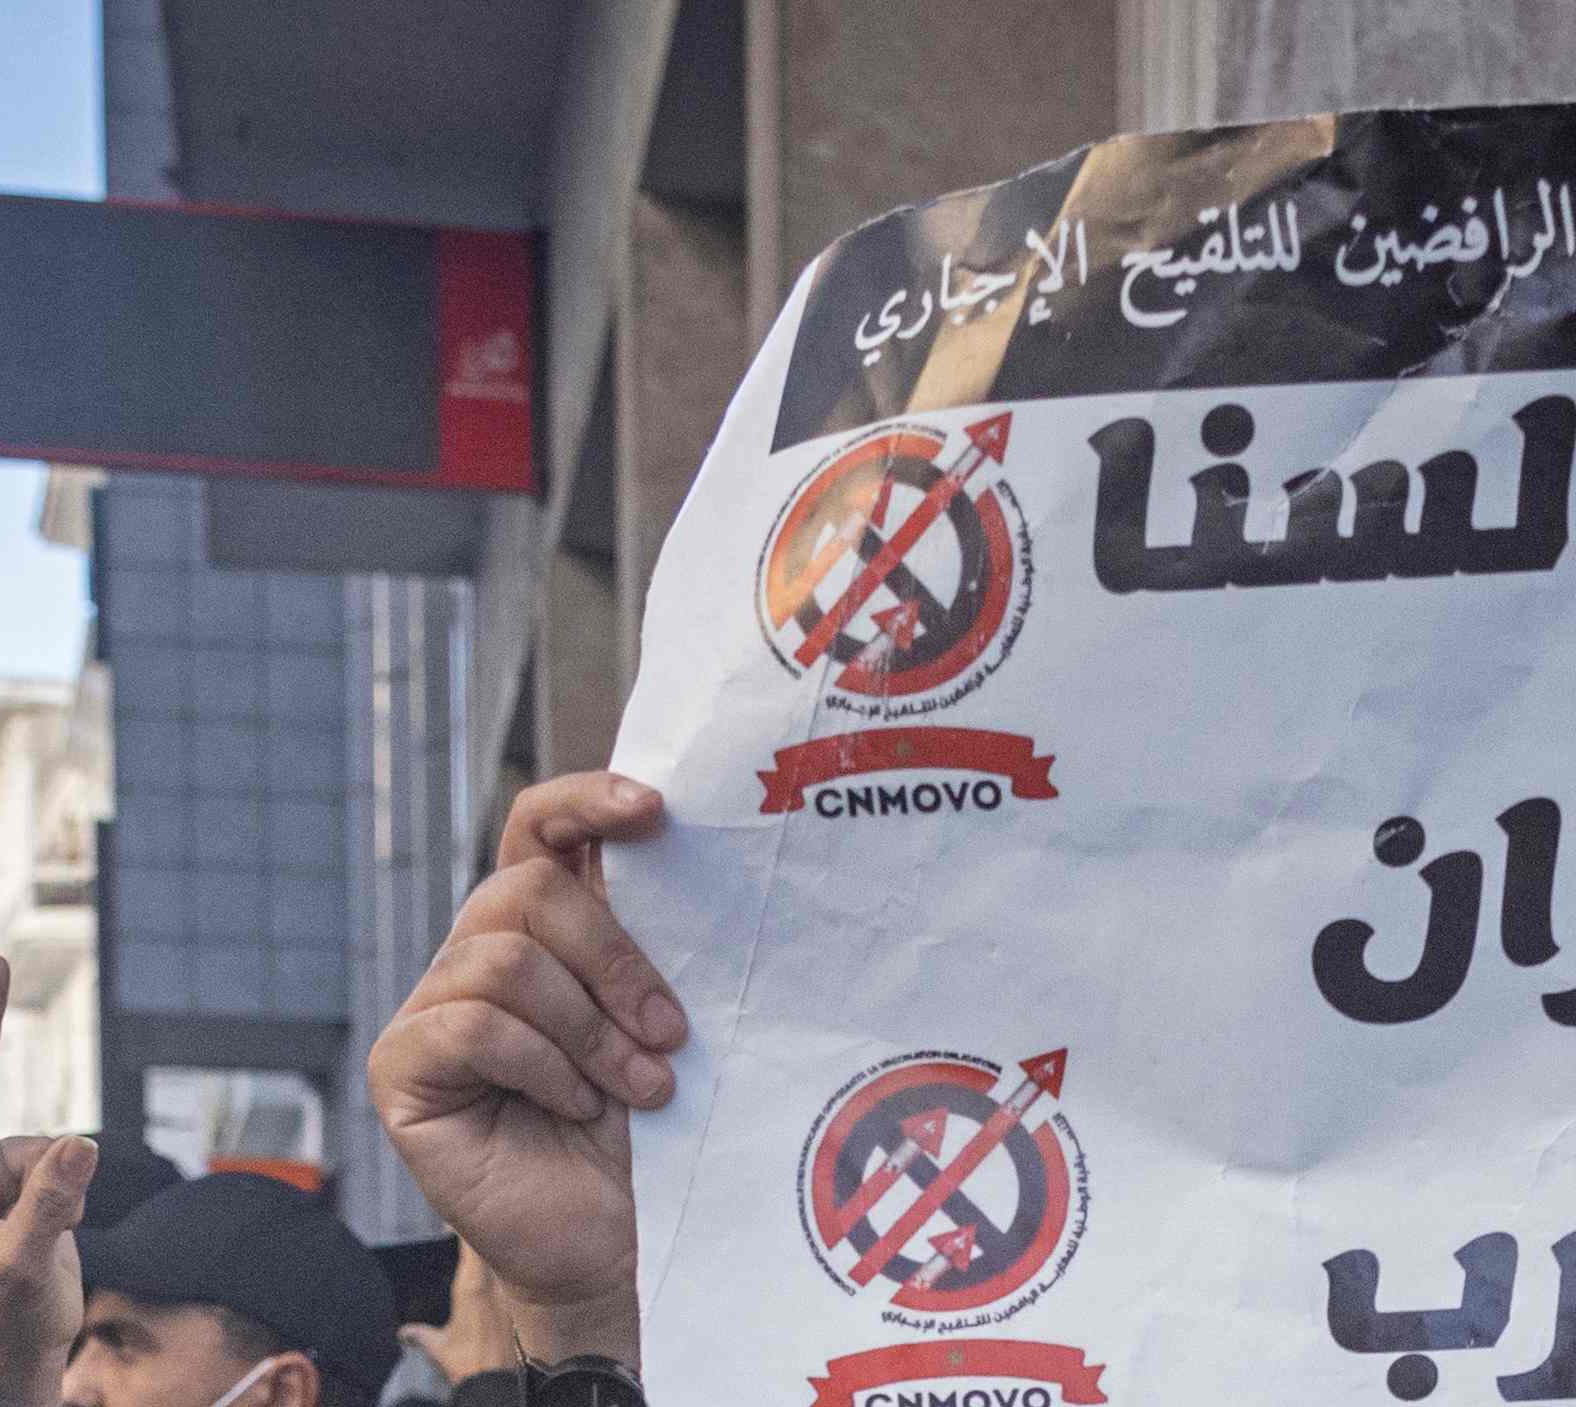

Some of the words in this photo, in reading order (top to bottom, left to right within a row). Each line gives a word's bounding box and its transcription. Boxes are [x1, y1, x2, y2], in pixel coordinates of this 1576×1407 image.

[853, 216, 1091, 366] الإجباري
[1119, 201, 1304, 328] للتلقيح
[1334, 178, 1576, 288] الرافضين
[814, 780, 1002, 819] CNMOVO
